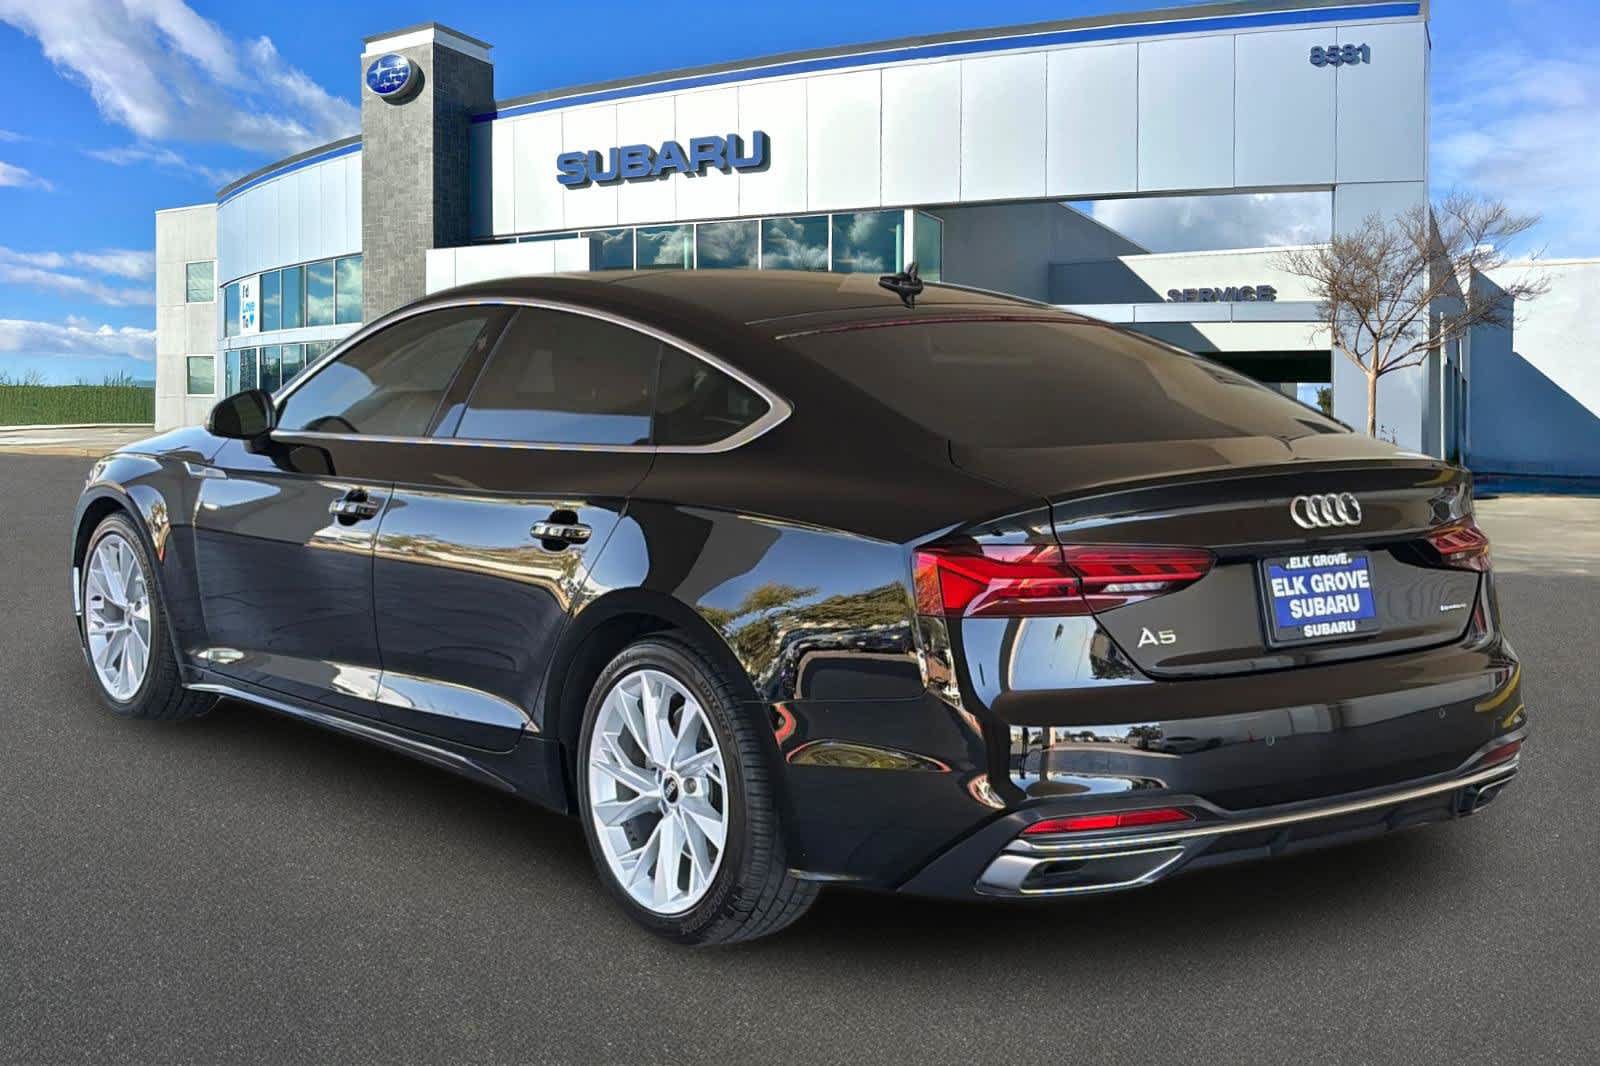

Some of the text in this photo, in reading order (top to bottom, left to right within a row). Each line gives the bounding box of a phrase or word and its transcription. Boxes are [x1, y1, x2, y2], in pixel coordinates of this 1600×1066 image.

[557, 130, 771, 190] SUBARU
[1166, 285, 1278, 302] SERVICE
[1271, 569, 1370, 597] ELK GROVE
[1289, 593, 1360, 618] SUBARU
[1137, 627, 1176, 648] A5
[1303, 620, 1356, 637] SUBARU
